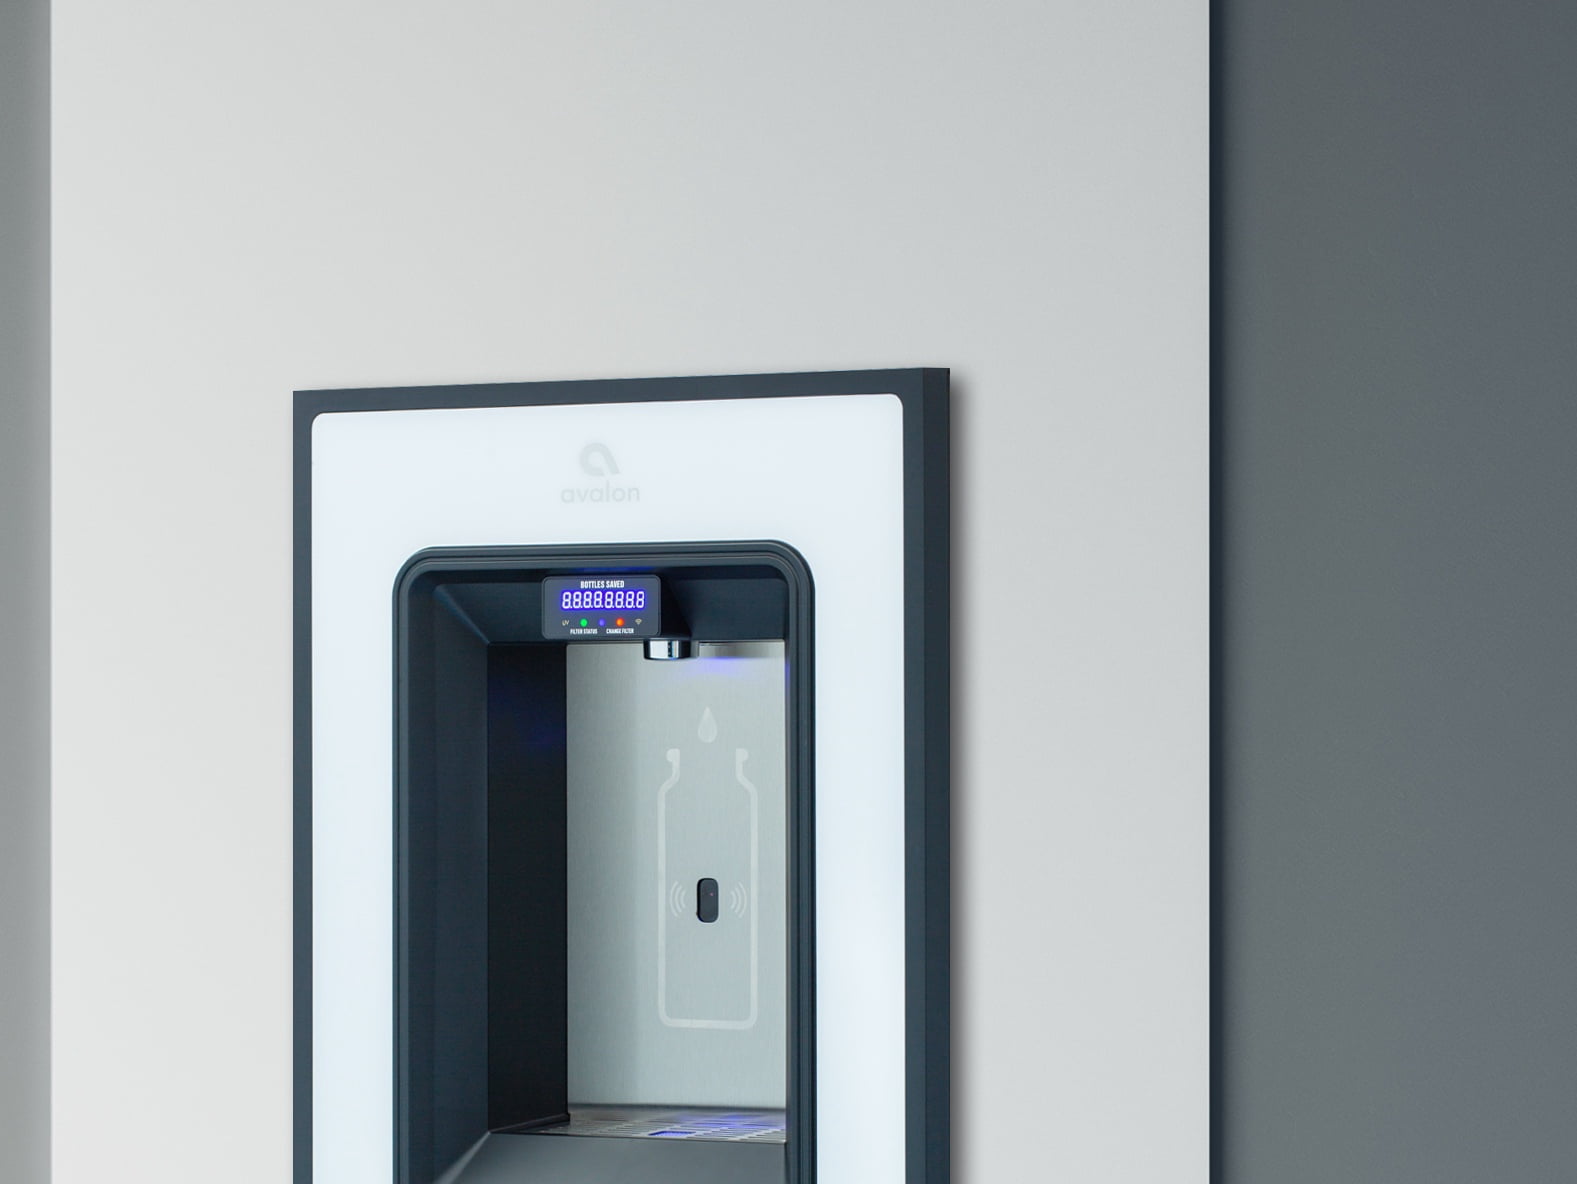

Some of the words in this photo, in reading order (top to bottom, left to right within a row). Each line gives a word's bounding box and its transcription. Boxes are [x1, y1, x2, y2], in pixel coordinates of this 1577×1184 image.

[560, 479, 640, 503] avalon
[580, 580, 605, 589] BOTTLES
[606, 580, 625, 589] SAVED
